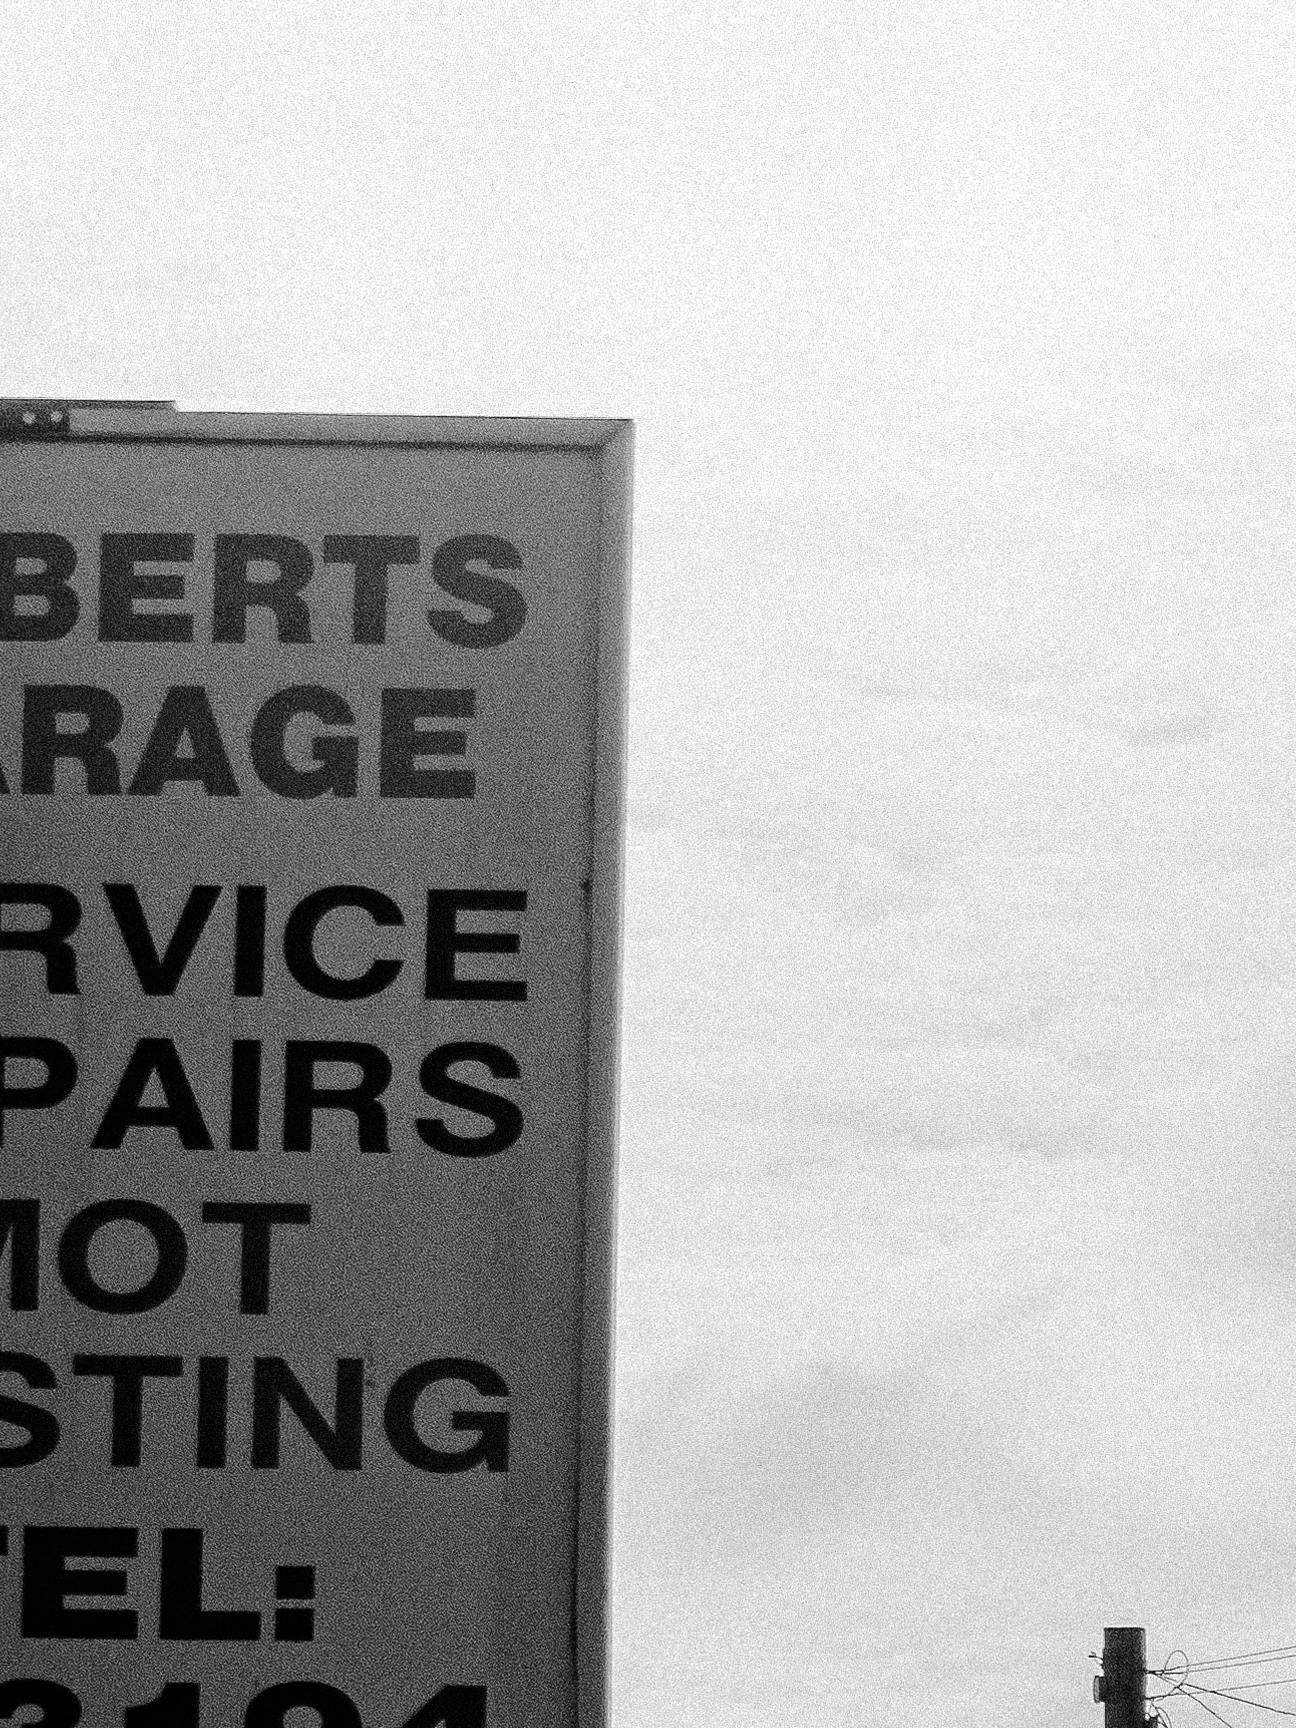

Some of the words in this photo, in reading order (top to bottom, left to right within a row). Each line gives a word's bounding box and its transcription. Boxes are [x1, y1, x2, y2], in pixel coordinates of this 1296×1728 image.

[0, 531, 528, 649] BERTS
[0, 684, 477, 800] RAGE
[0, 882, 528, 1001] RVICE
[0, 1036, 524, 1158] PAIRS
[0, 1350, 511, 1474] STING
[0, 1526, 315, 1642] EL:
